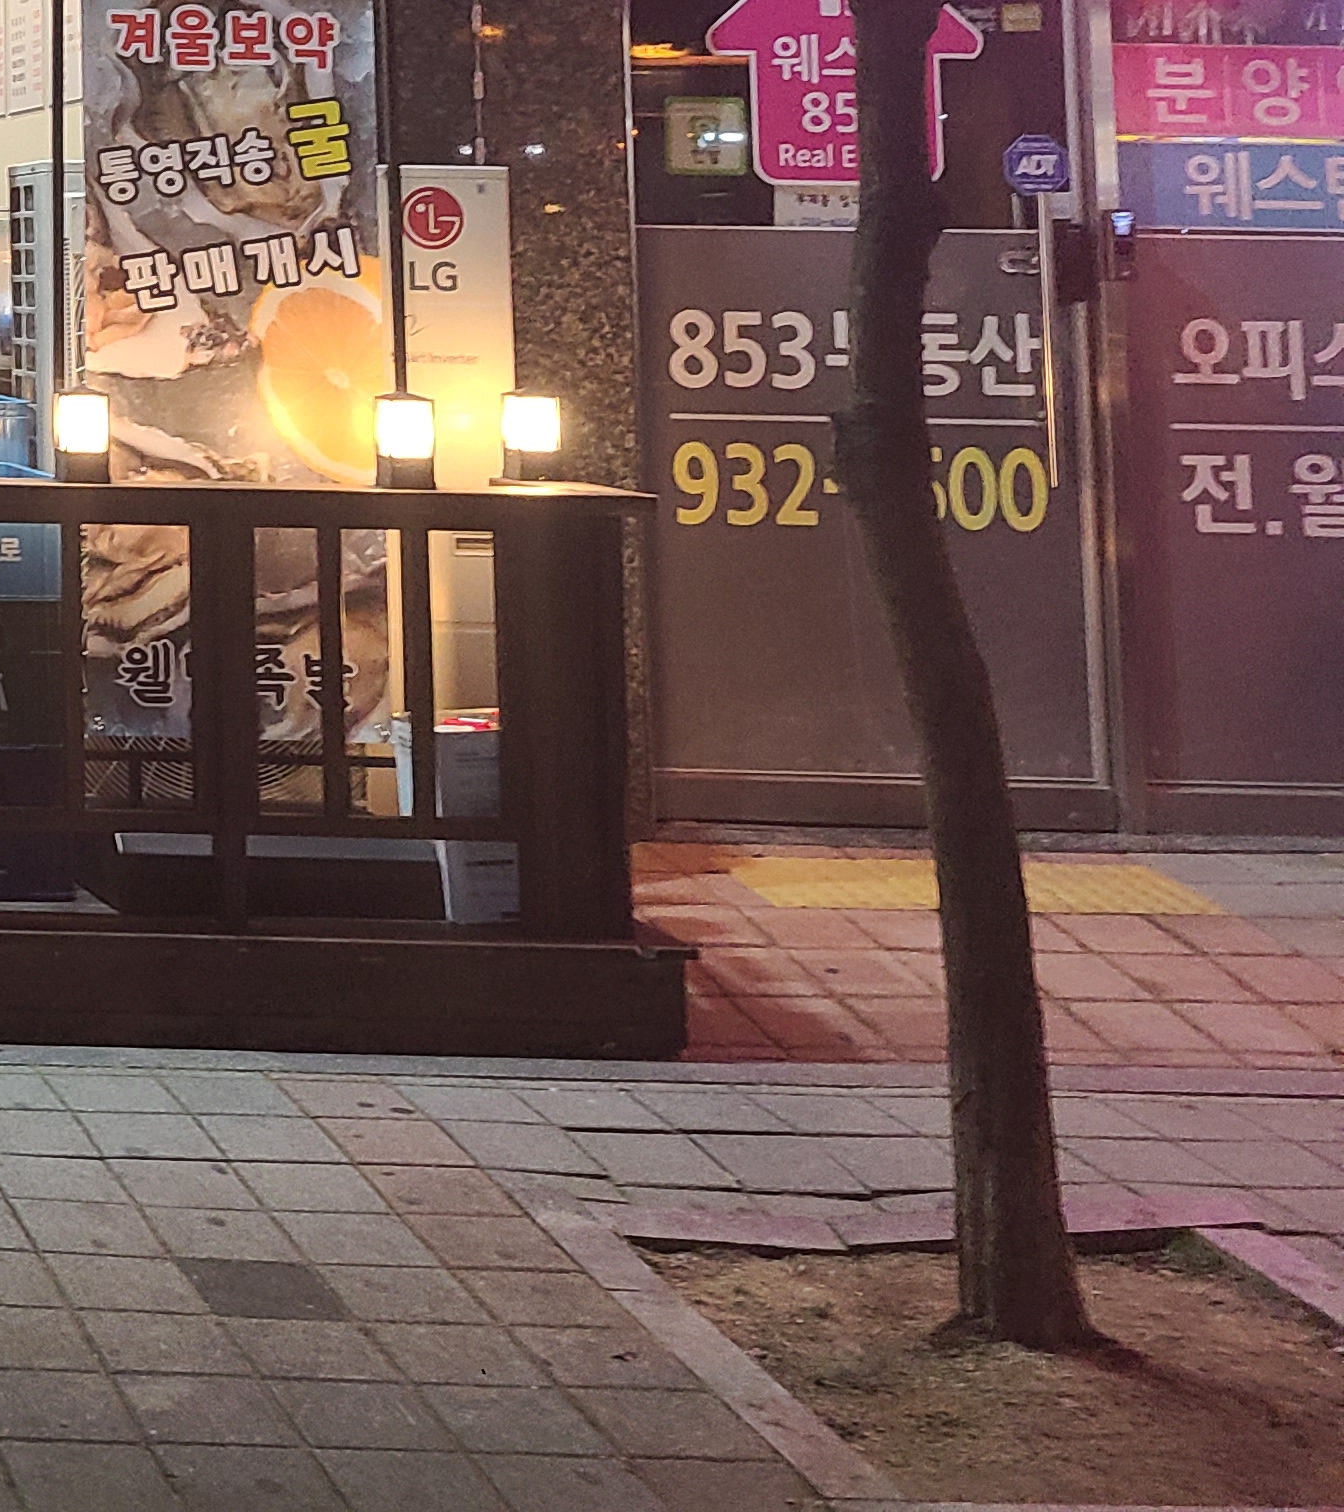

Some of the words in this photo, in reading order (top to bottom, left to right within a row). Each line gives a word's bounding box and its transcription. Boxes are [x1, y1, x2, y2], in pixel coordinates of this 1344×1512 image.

[771, 33, 857, 84] 웨스
[801, 91, 859, 133] 85
[96, 126, 276, 205] 통영직송
[284, 96, 353, 182] 굴
[778, 143, 834, 168] Real
[1014, 154, 1057, 177] ADT
[119, 224, 363, 314] 판매개시
[408, 261, 459, 292] LG
[668, 308, 1043, 397] 853동산
[114, 637, 360, 711] 웰족발
